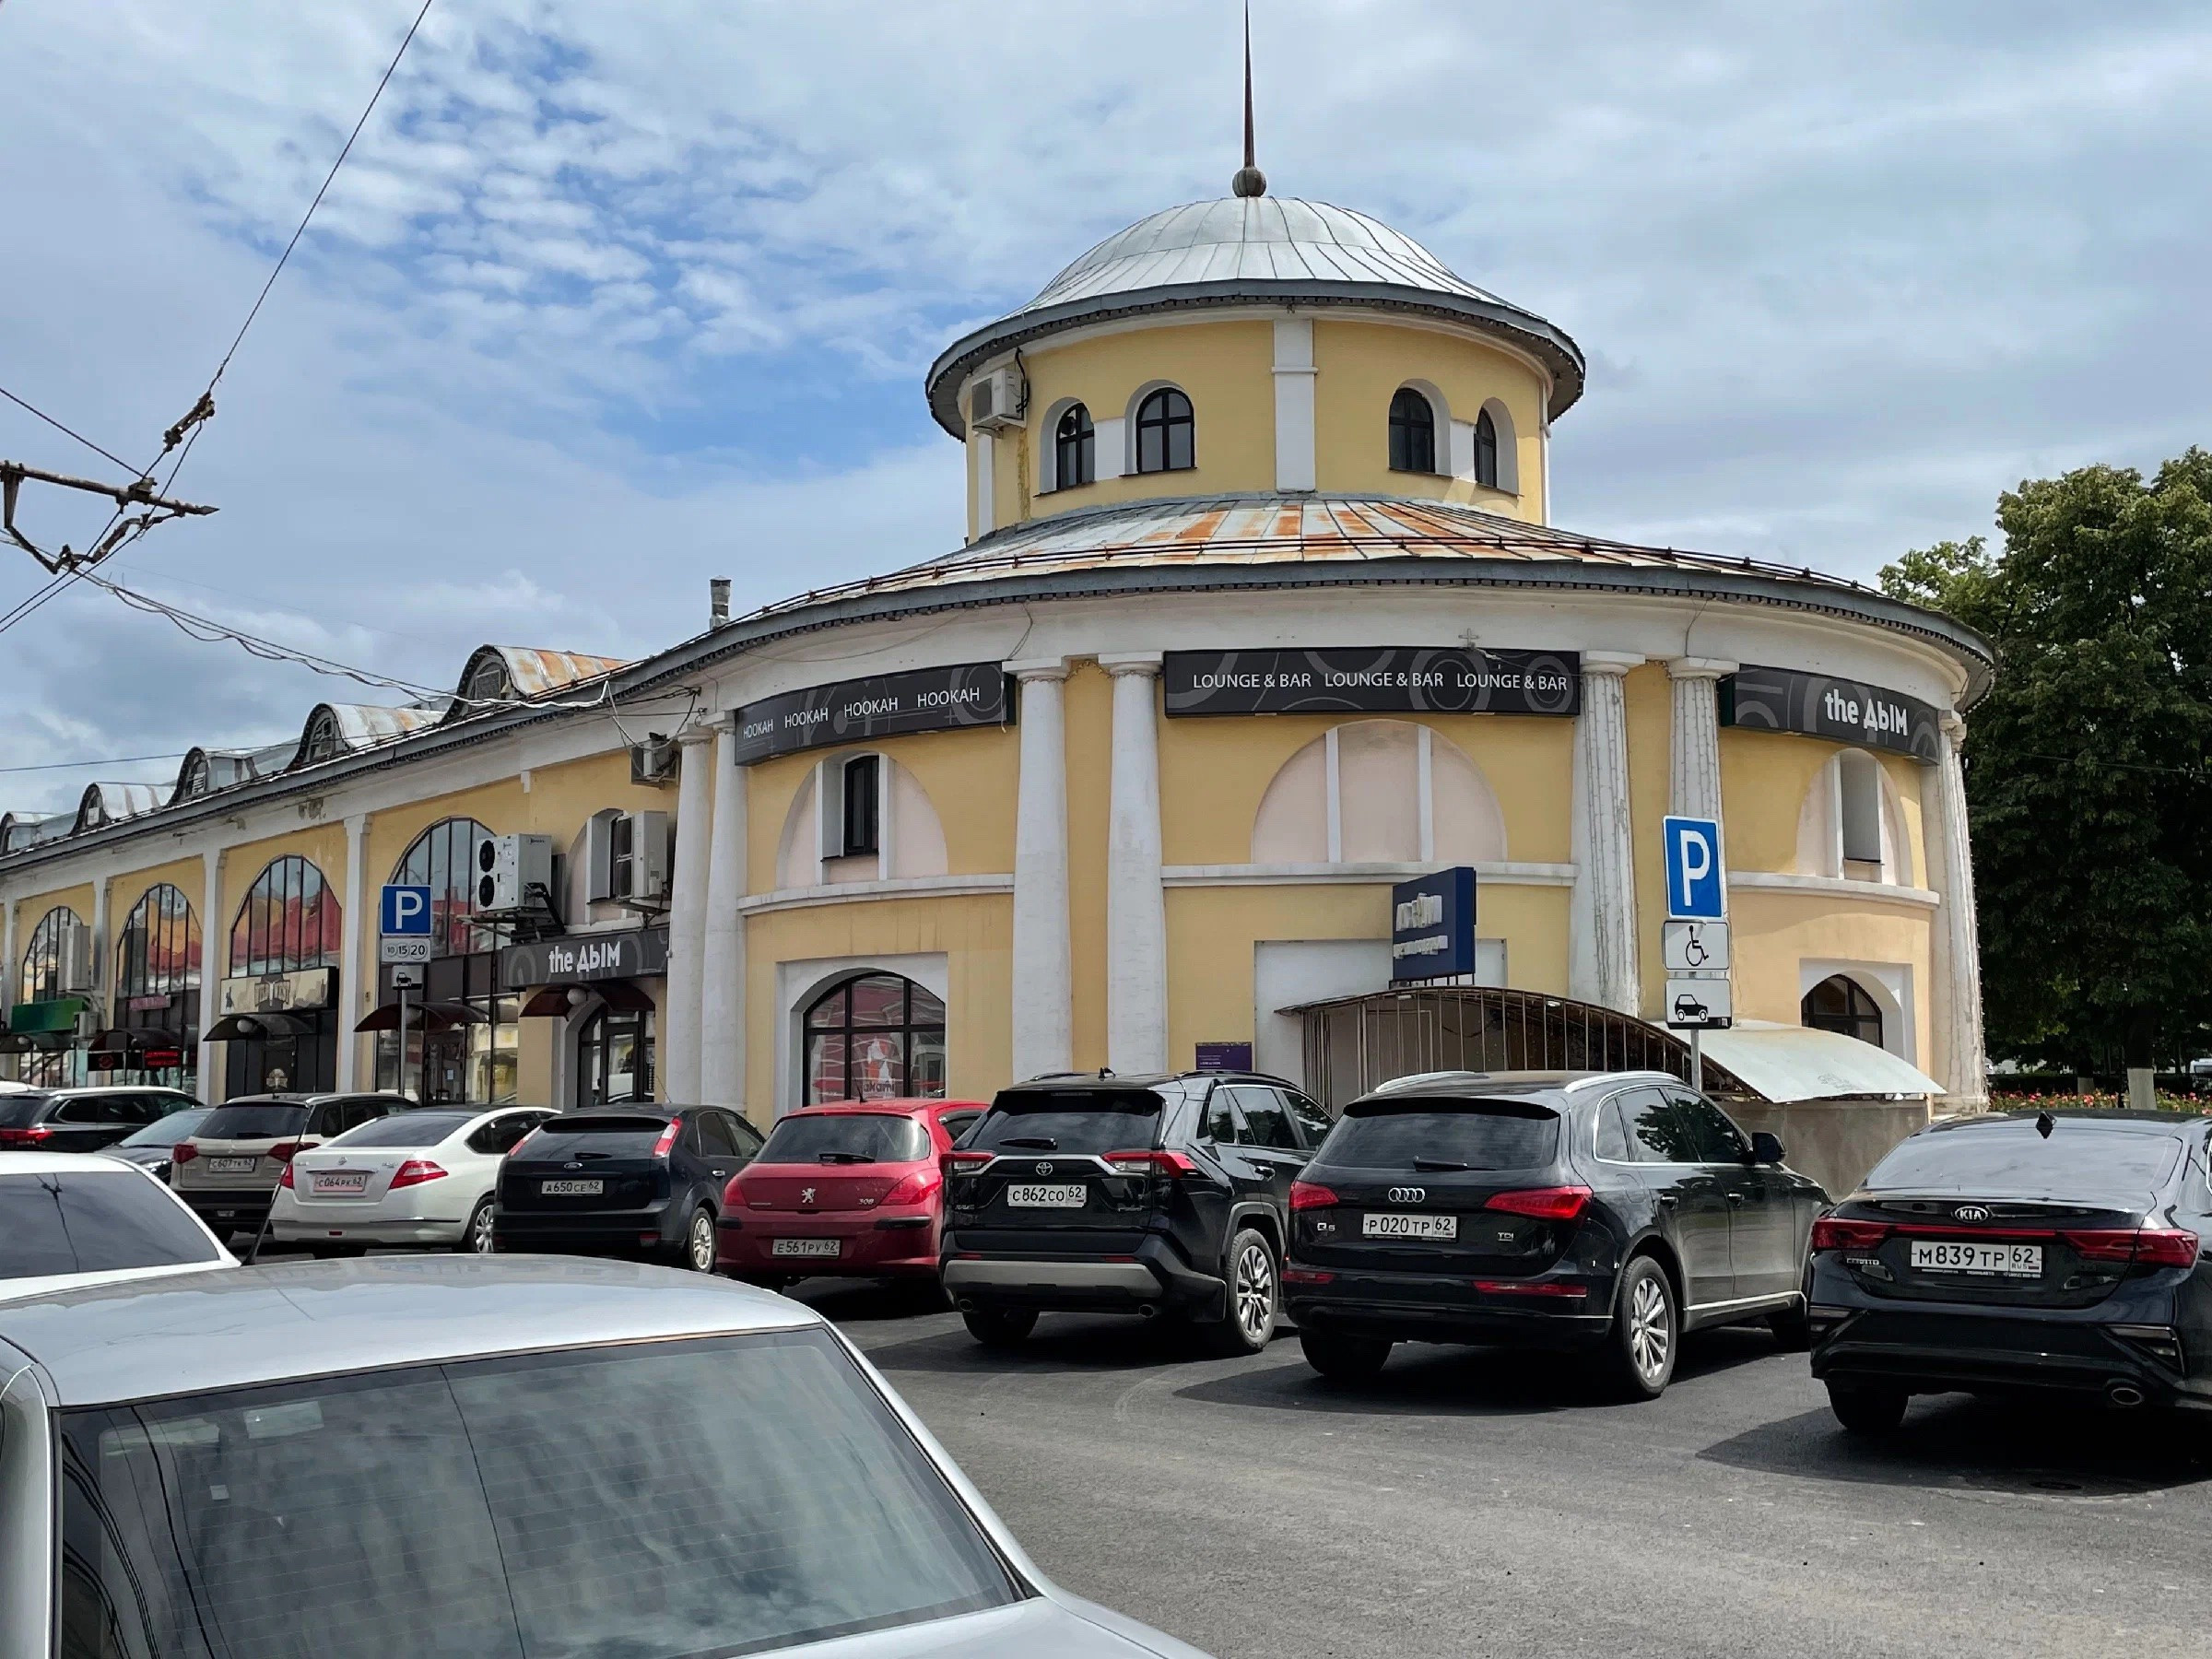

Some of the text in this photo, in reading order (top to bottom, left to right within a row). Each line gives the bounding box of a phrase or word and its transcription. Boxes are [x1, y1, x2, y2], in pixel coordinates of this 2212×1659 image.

[1193, 672, 1568, 691] LOUNGE & BAR LOUNGE & BAR LOUNGE & BAR
[743, 687, 980, 739] HOOKAH HOOKAH HOOKAH HOOKAH
[1824, 688, 1859, 724] the
[398, 945, 407, 955] 15
[410, 945, 426, 956] 20
[548, 946, 573, 973] the
[1068, 1186, 1082, 1197] 62
[1959, 1210, 1983, 1220] KIA
[1435, 1218, 1451, 1231] 62
[1498, 1231, 1514, 1240] TDI
[2012, 1248, 2033, 1264] 62
